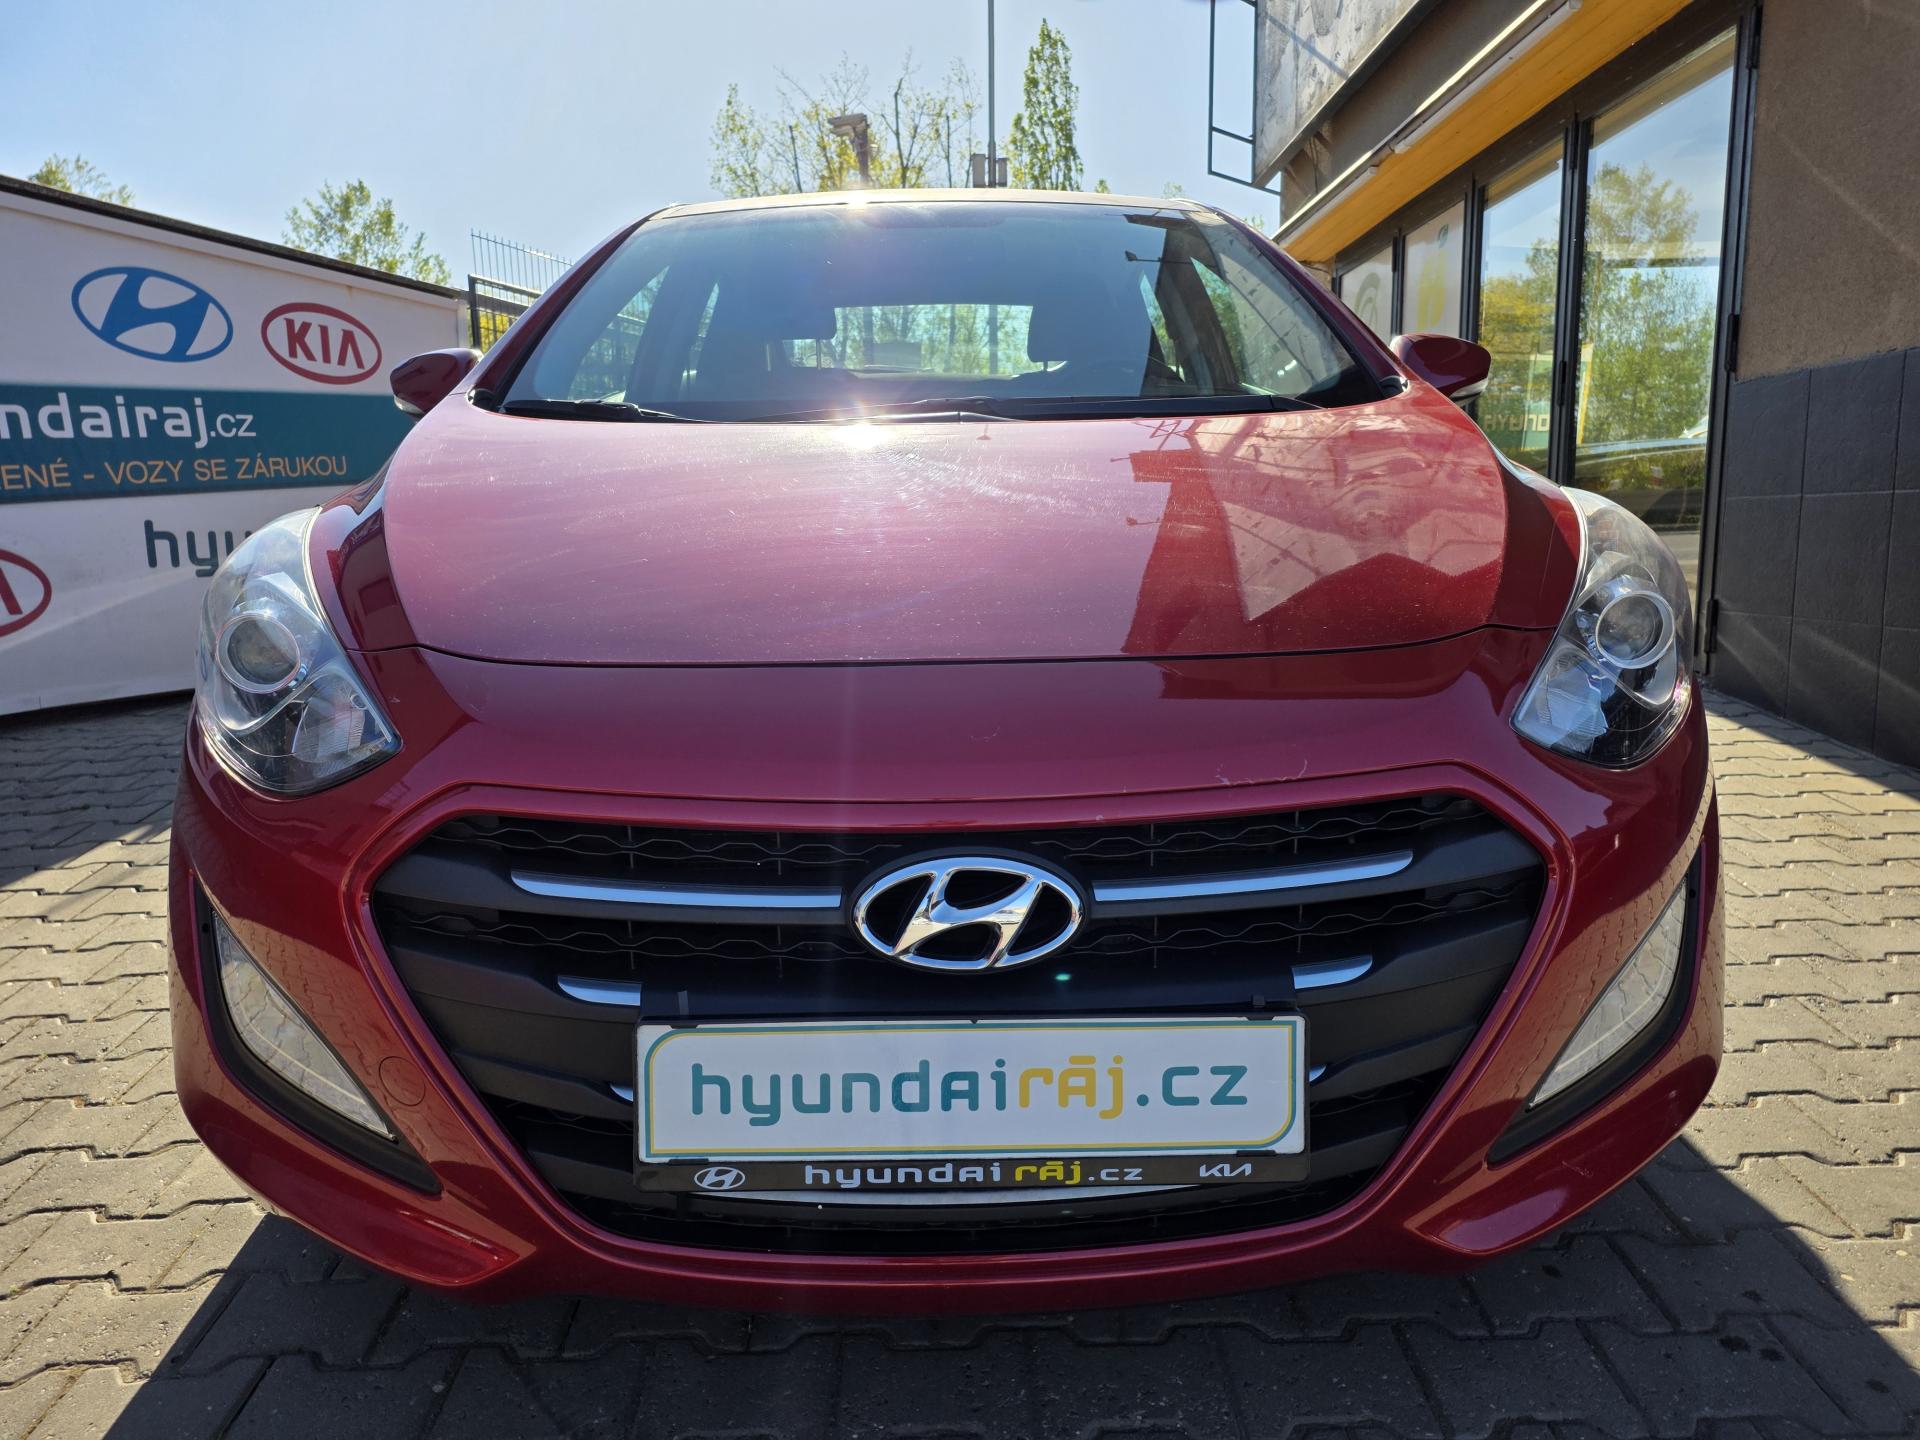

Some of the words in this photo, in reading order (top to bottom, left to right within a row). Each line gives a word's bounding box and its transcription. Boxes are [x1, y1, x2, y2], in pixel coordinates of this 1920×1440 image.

[284, 317, 365, 370] KIA
[0, 457, 72, 490] ENÉ
[104, 460, 183, 485] VOZY
[193, 458, 228, 481] SE
[235, 453, 347, 480] ZÁRUKOU
